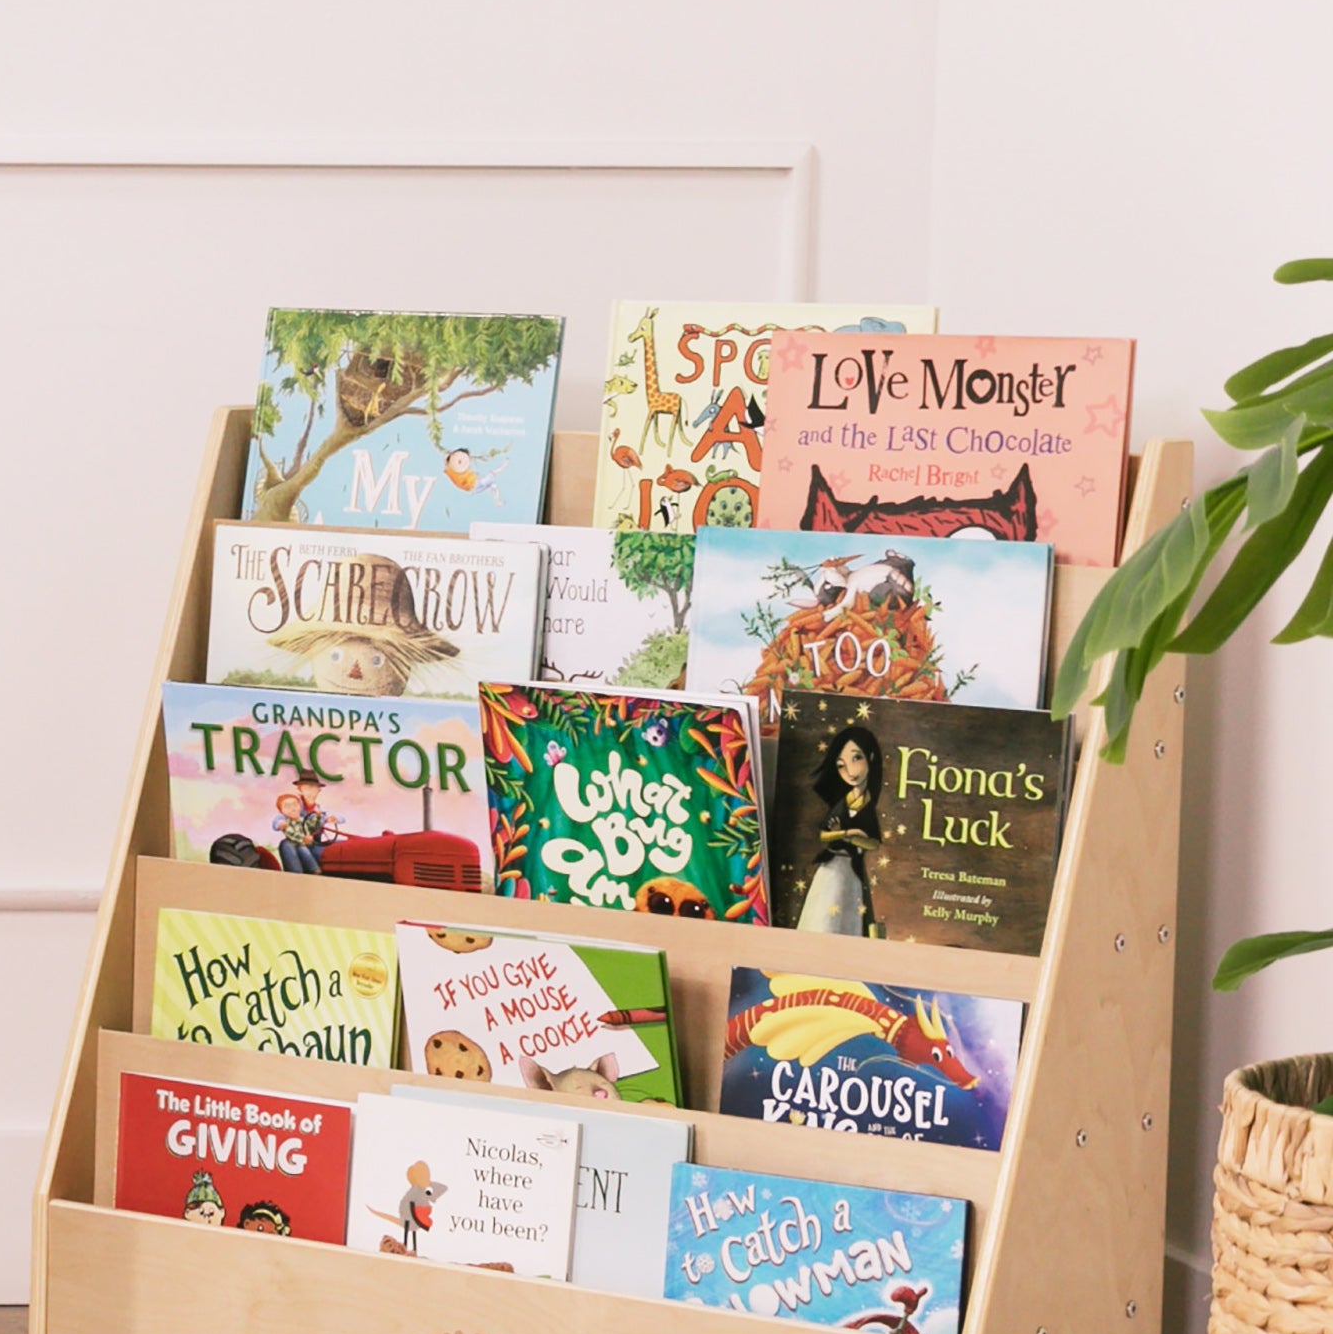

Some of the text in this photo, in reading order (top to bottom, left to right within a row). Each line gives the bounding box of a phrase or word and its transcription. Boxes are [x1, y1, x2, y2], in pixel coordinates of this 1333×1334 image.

[674, 333, 772, 387] SPO
[919, 359, 1076, 417] Monster
[798, 424, 1072, 456] and the Last Chocolate
[343, 449, 438, 530] My
[868, 464, 979, 487] Rachel Bright
[299, 544, 358, 558] BETH FERRY
[403, 551, 506, 567] THE FAN BROTHERS
[231, 543, 515, 635] THE SCARECROW
[546, 576, 608, 603] Would
[803, 631, 891, 678] TOO
[252, 702, 401, 734] GRANDPA'S
[191, 722, 471, 792] TRACTOR
[897, 746, 1045, 801] Fiona's
[591, 812, 692, 877] Bug
[921, 798, 1013, 849] Luck
[921, 867, 1006, 887] Teresa Bateman
[932, 889, 993, 907] Illustrated by
[923, 905, 999, 927] Kelly Murphy
[173, 943, 251, 1010] How
[220, 950, 343, 1041] Catch a
[434, 952, 557, 1010] IF YOU GIVE
[484, 985, 577, 1031] A MOUSE
[499, 1011, 598, 1065] A COOKIE
[836, 1055, 858, 1072] THE
[156, 1089, 323, 1134] The Little Book of
[771, 1060, 949, 1130] CAROUSEL
[166, 1119, 307, 1176] GIVING
[465, 1137, 544, 1169] Nicolas,
[473, 1167, 533, 1190] where
[477, 1190, 524, 1213] have
[449, 1215, 549, 1242] you been?
[685, 1184, 756, 1238] How
[720, 1195, 852, 1284] Catch a
